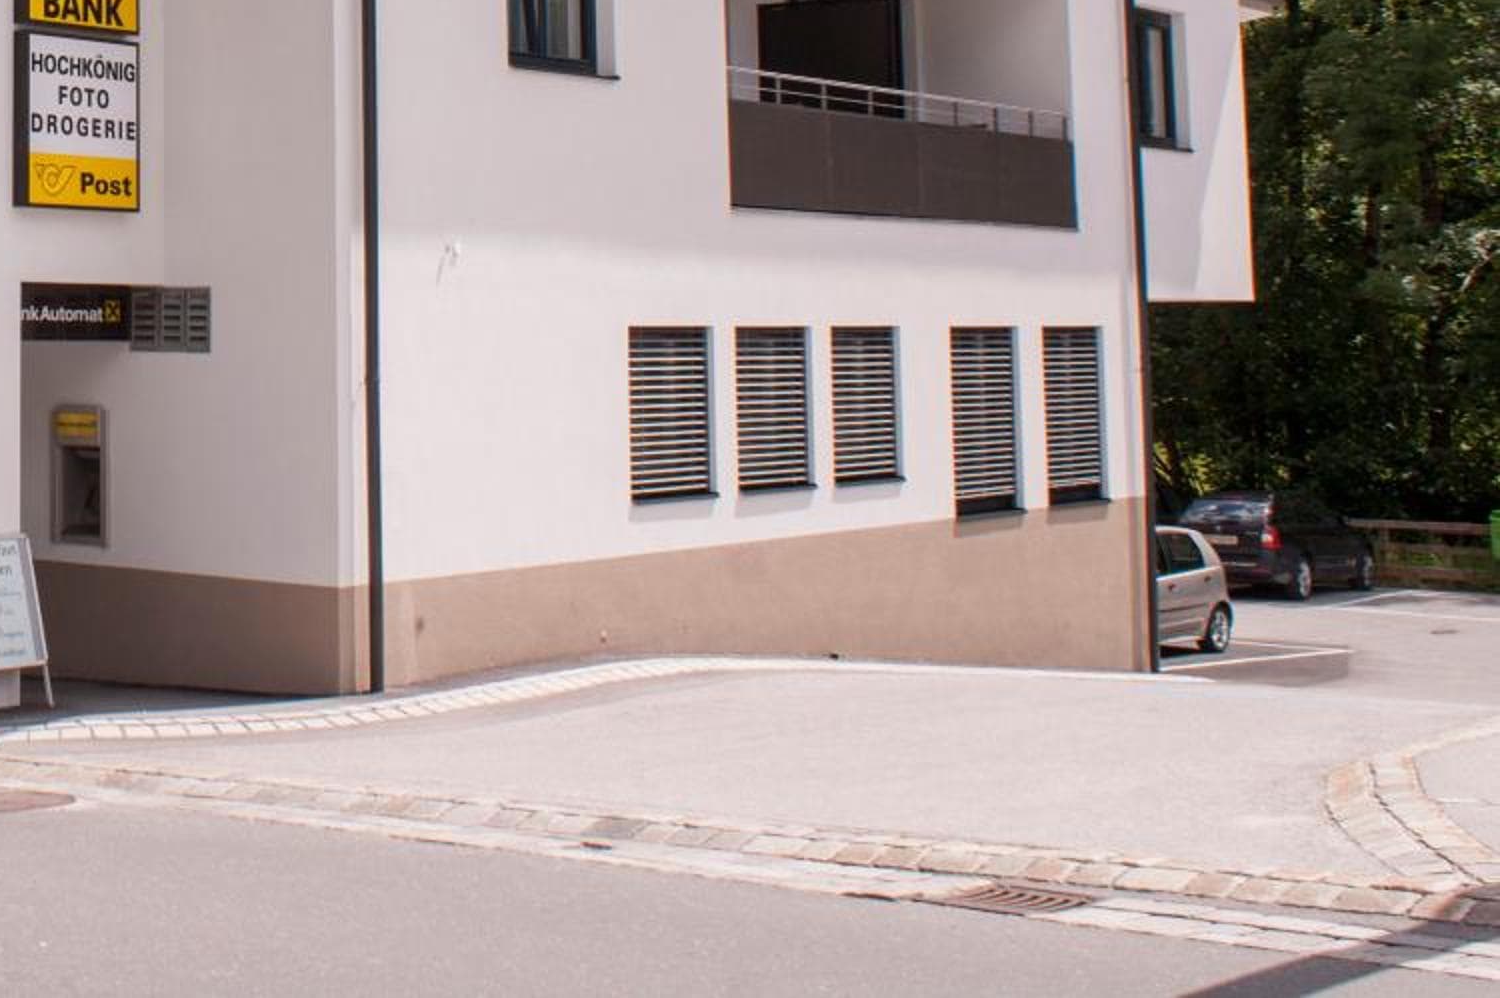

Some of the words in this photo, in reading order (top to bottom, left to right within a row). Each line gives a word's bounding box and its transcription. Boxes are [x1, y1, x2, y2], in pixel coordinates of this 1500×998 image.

[31, 52, 136, 83] HOCHKÖNIG
[58, 85, 110, 109] FOTO
[31, 113, 137, 141] DROGERIE
[80, 172, 132, 197] Post
